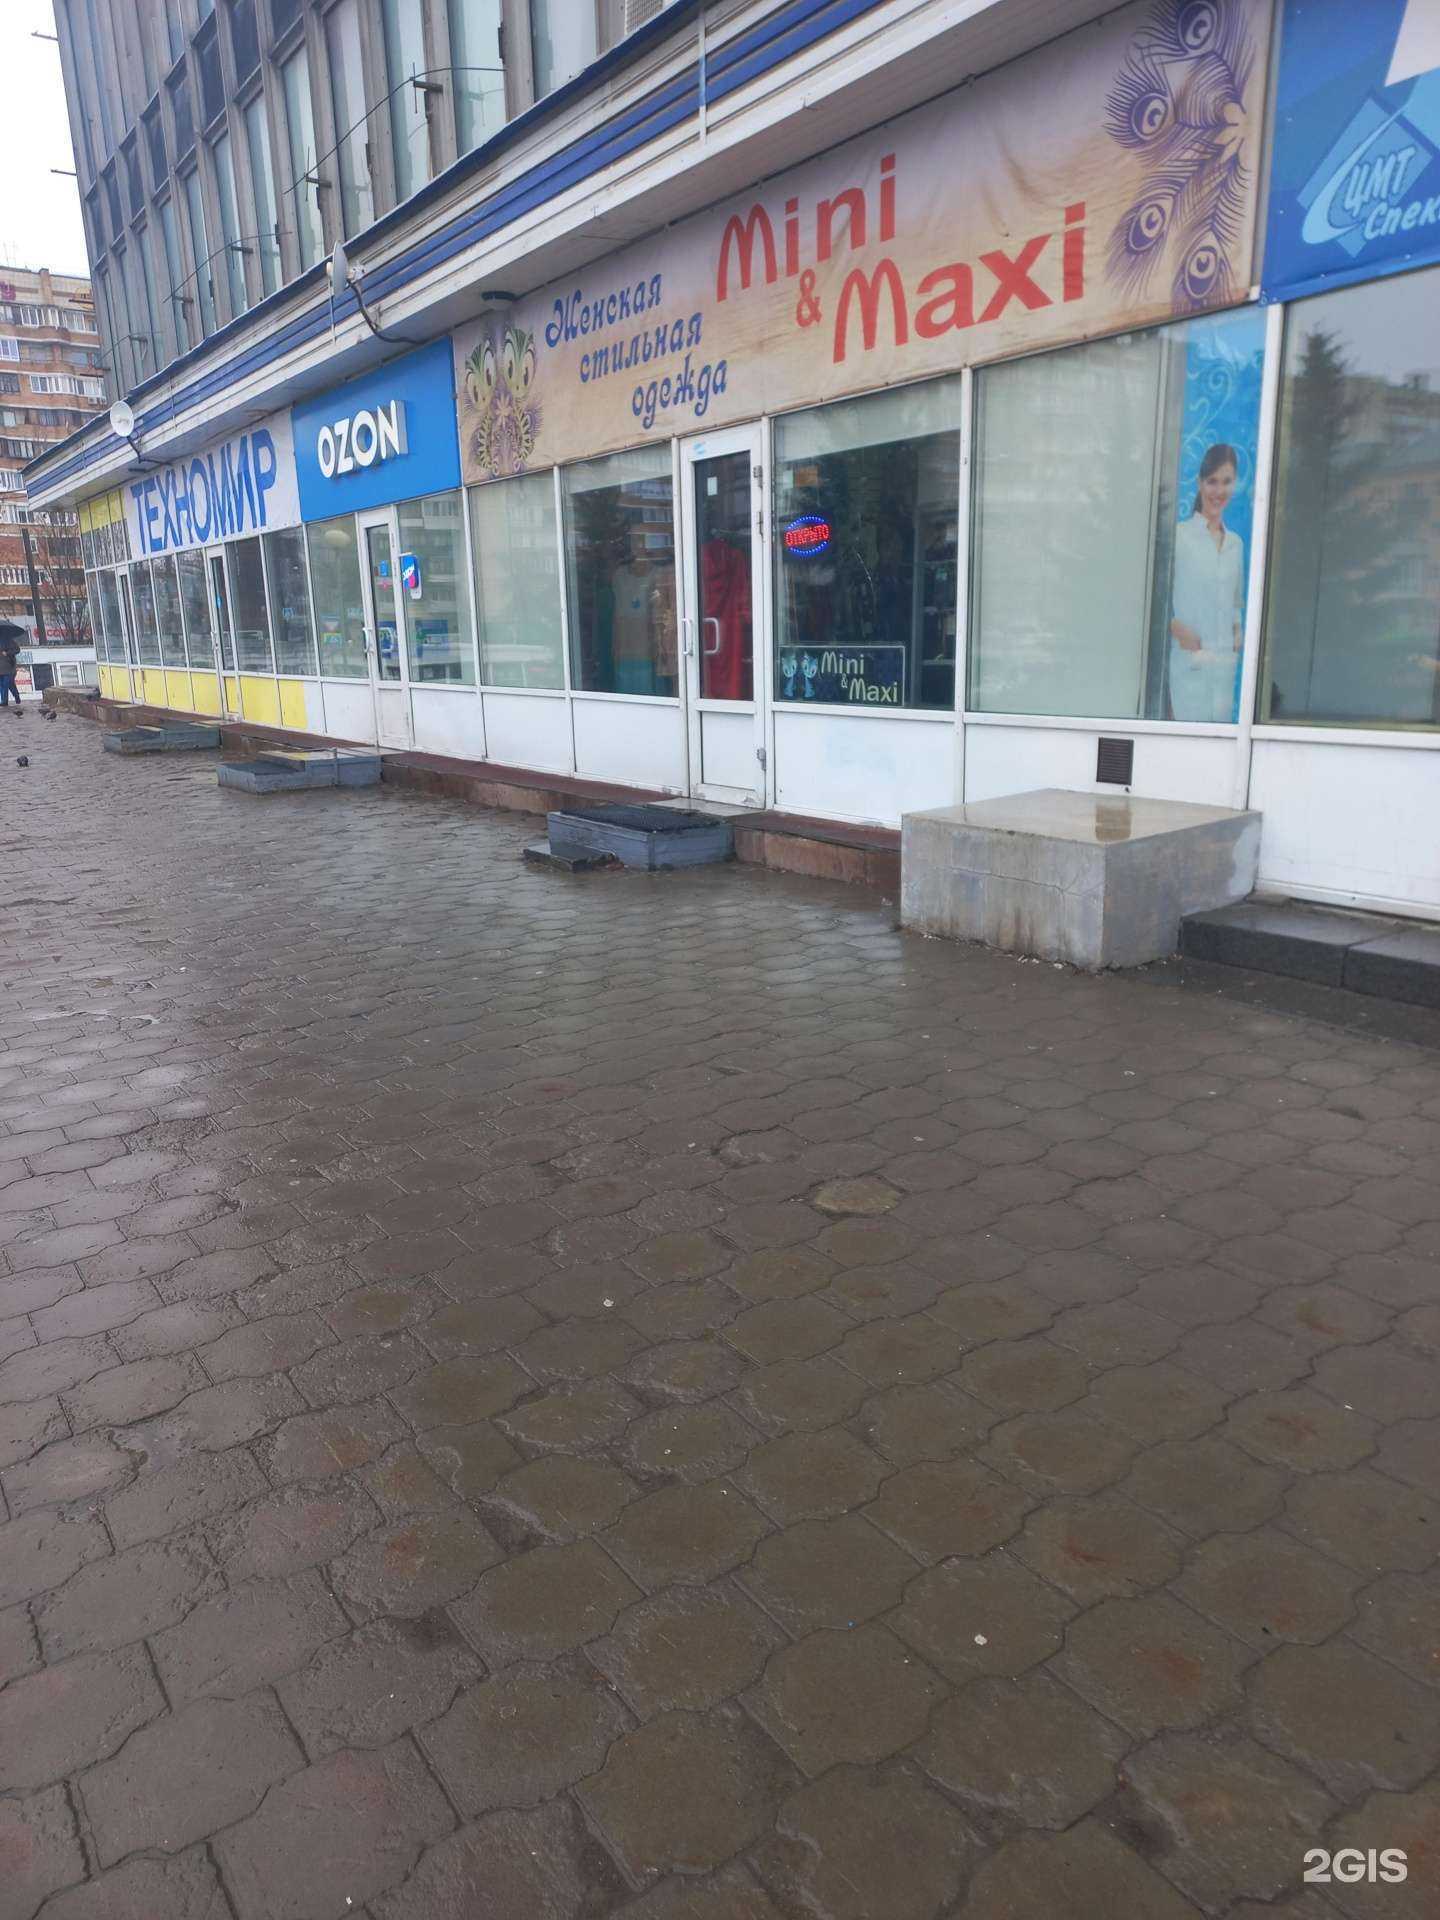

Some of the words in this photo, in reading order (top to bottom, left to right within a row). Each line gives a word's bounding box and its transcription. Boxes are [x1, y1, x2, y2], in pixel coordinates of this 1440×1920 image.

[716, 153, 896, 303] Mini
[1364, 193, 1440, 240] Спек
[545, 273, 662, 348] Женская
[796, 266, 822, 328] &
[833, 202, 1085, 364] Maxi
[580, 311, 702, 383] стильная
[632, 351, 727, 430] одежда
[317, 399, 402, 478] OZON
[130, 428, 277, 555] ТЕХНОМИР
[821, 651, 865, 674] Mini
[841, 673, 848, 689] &
[849, 678, 898, 703] Maxi
